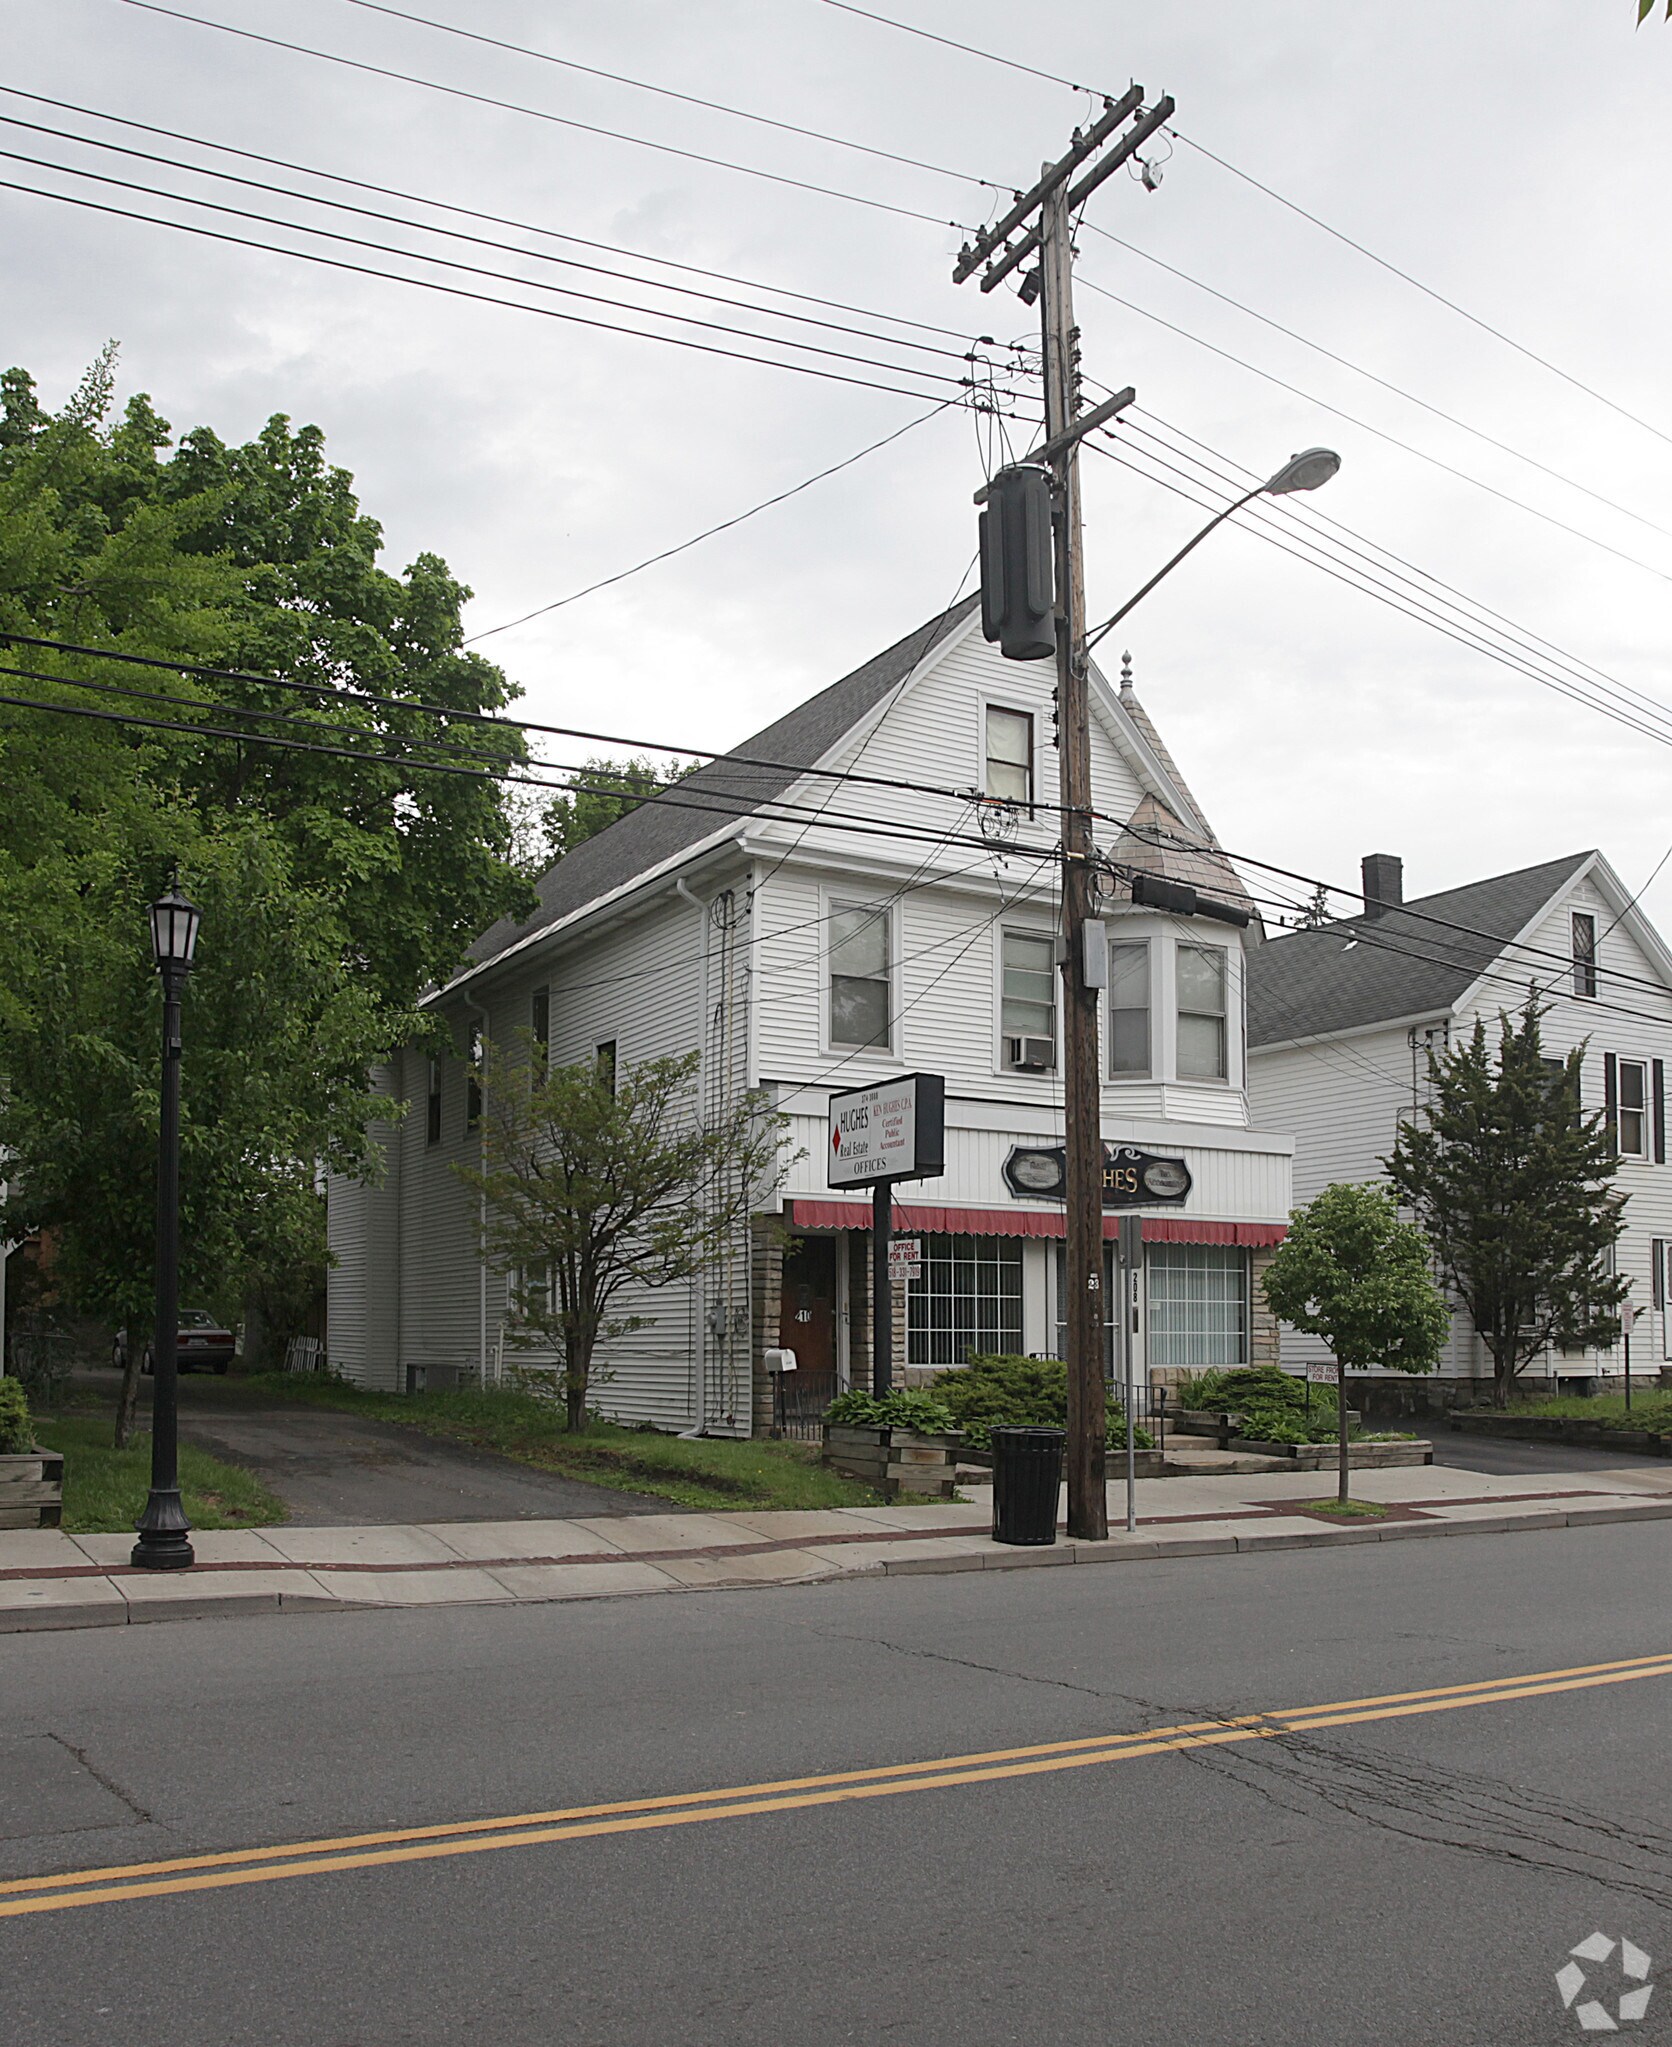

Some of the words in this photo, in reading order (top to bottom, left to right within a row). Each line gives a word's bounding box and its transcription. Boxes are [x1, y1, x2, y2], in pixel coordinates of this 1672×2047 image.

[873, 1104, 882, 1117] KEN
[882, 1100, 901, 1115] HUGHES
[840, 1106, 868, 1133] HUGHES
[882, 1116, 902, 1127] Certified
[885, 1129, 899, 1138] Public
[840, 1142, 851, 1157] Real
[853, 1141, 869, 1155] Estate
[880, 1139, 904, 1150] Accountant
[854, 1157, 886, 1174] OFFICES
[893, 1243, 915, 1252] OFFICE
[889, 1253, 901, 1261] FOR
[903, 1252, 919, 1260] RENT
[1088, 1279, 1099, 1289] 23
[1308, 1365, 1324, 1373] STORE
[1326, 1366, 1338, 1374] FRO
[1312, 1373, 1323, 1381] FOR
